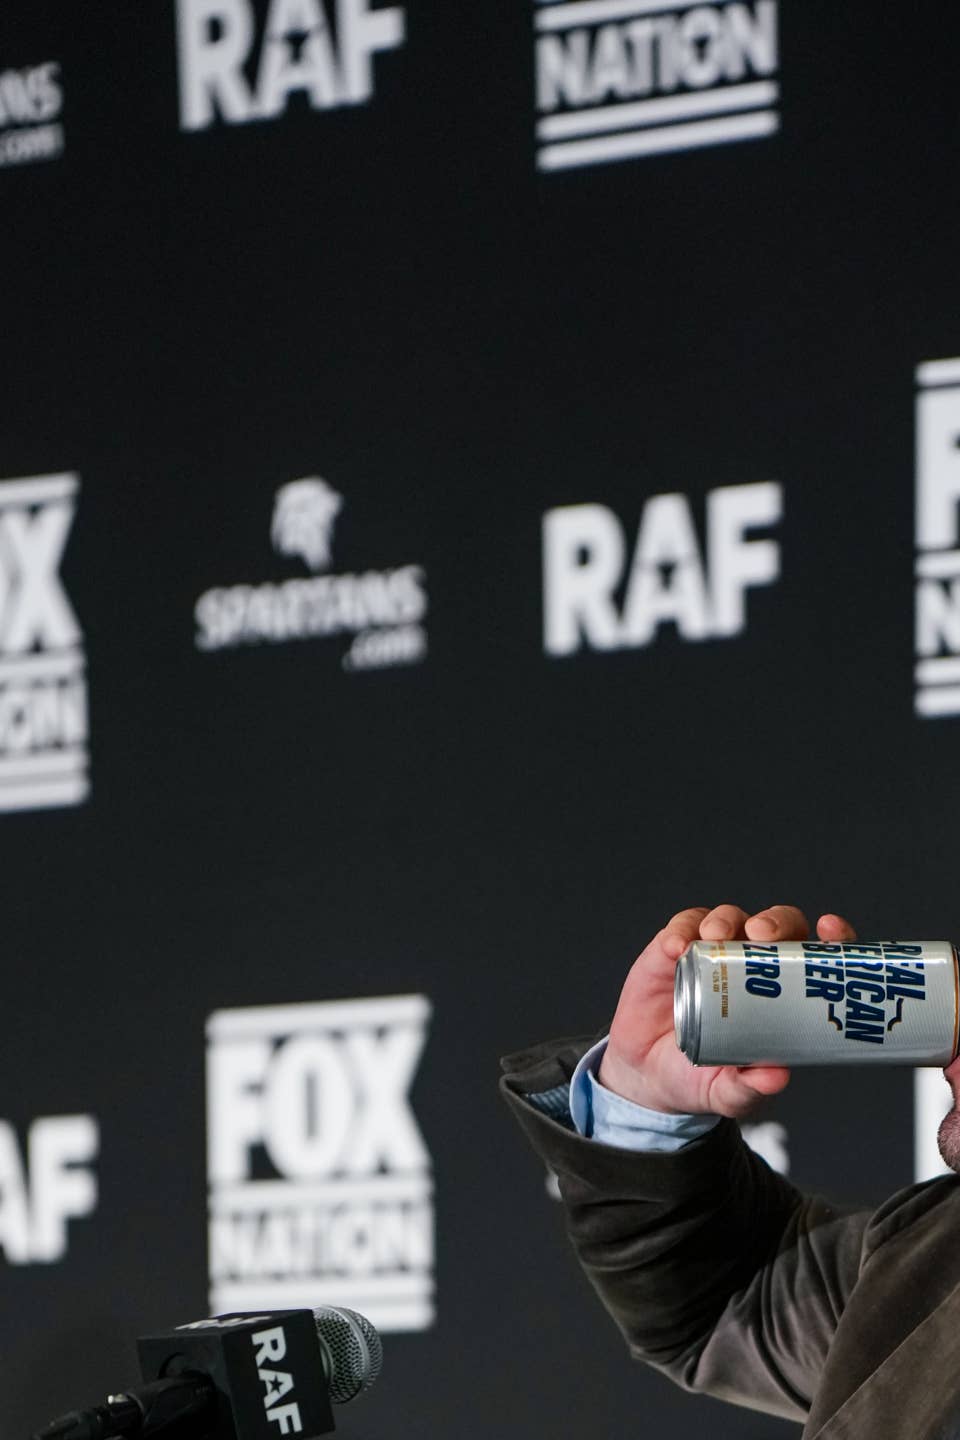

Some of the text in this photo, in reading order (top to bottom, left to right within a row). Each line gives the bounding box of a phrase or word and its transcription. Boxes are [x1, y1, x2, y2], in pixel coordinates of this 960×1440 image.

[175, 0, 404, 131] RAF
[536, 0, 778, 112] NATION
[542, 481, 783, 656] RAF
[742, 943, 782, 998] ZERO
[842, 942, 886, 1045] ERICAN
[881, 943, 926, 1000] REAL
[207, 1026, 432, 1184] FOX
[209, 1204, 433, 1281] NATION
[251, 1325, 303, 1436] RAF
